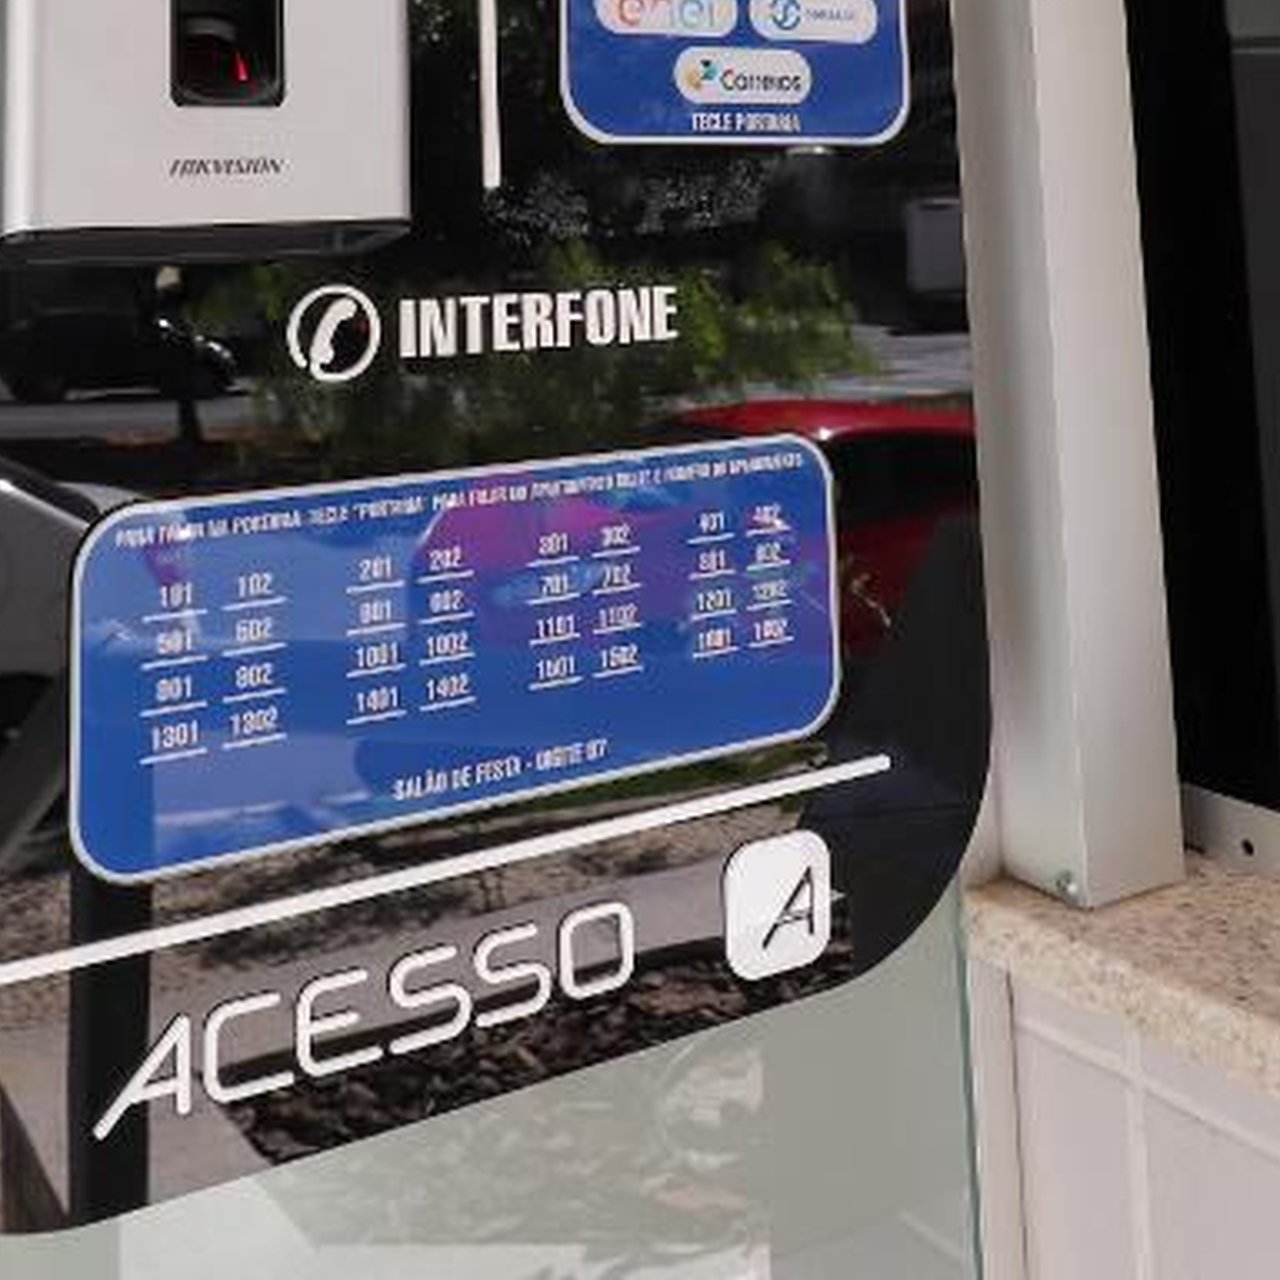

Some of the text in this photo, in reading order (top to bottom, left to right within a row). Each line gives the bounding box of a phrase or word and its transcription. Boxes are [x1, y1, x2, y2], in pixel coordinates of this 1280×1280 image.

[720, 68, 801, 93] Correios
[398, 286, 680, 359] INTERFONE
[237, 572, 274, 598] 102
[359, 555, 393, 582] 201
[427, 632, 469, 658] 1002
[536, 614, 575, 639] 1101
[151, 721, 200, 750] 1301
[356, 686, 399, 714] 1401
[392, 767, 449, 802] SALÃO
[452, 764, 471, 788] DE
[92, 864, 818, 1140] ACESSO A
